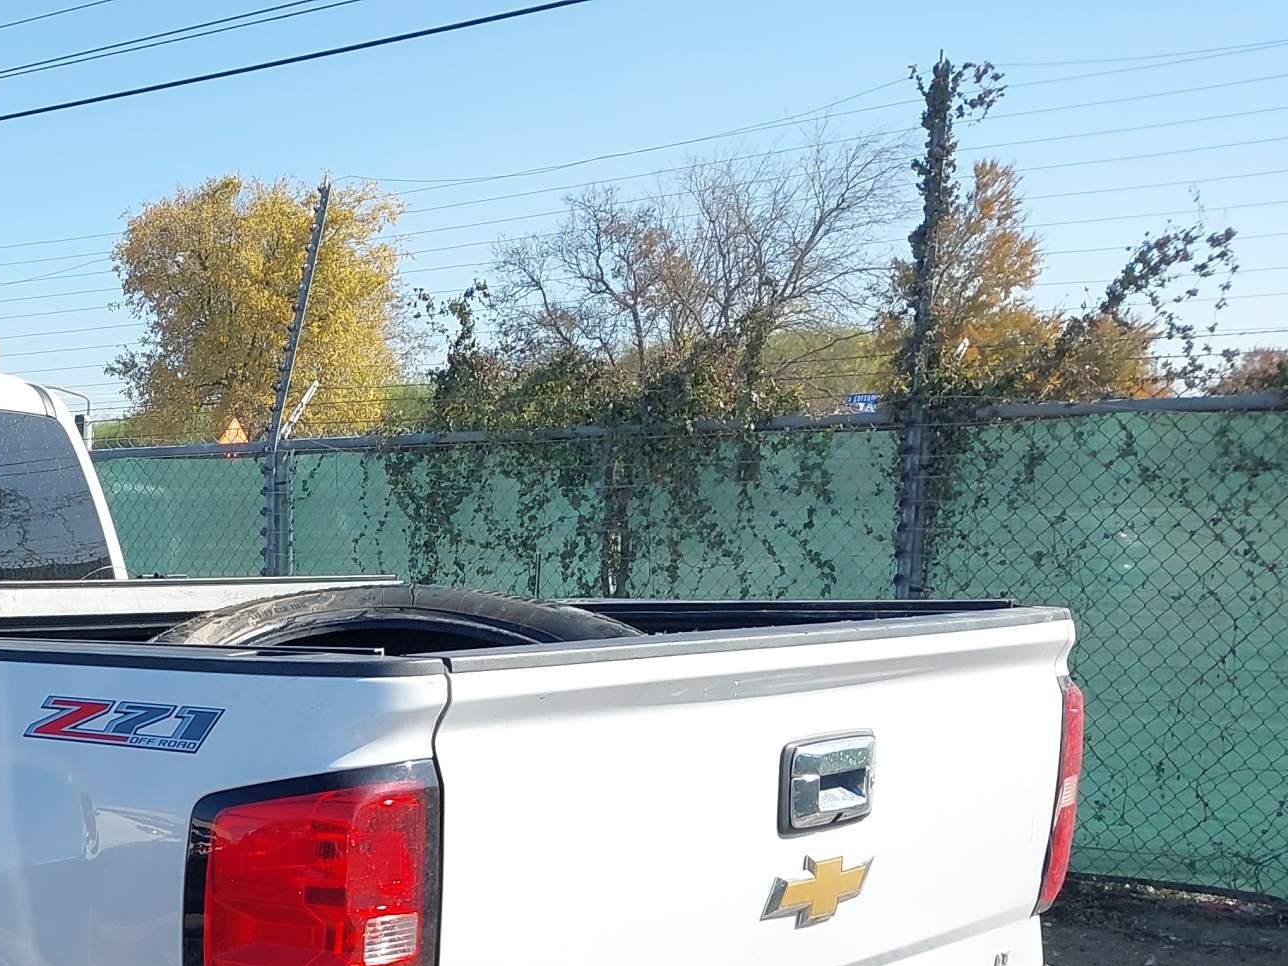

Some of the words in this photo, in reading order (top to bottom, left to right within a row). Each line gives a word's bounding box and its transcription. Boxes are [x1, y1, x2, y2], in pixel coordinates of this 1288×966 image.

[23, 695, 225, 746] Z71
[129, 736, 157, 745] OFF
[158, 739, 198, 750] ROAD
